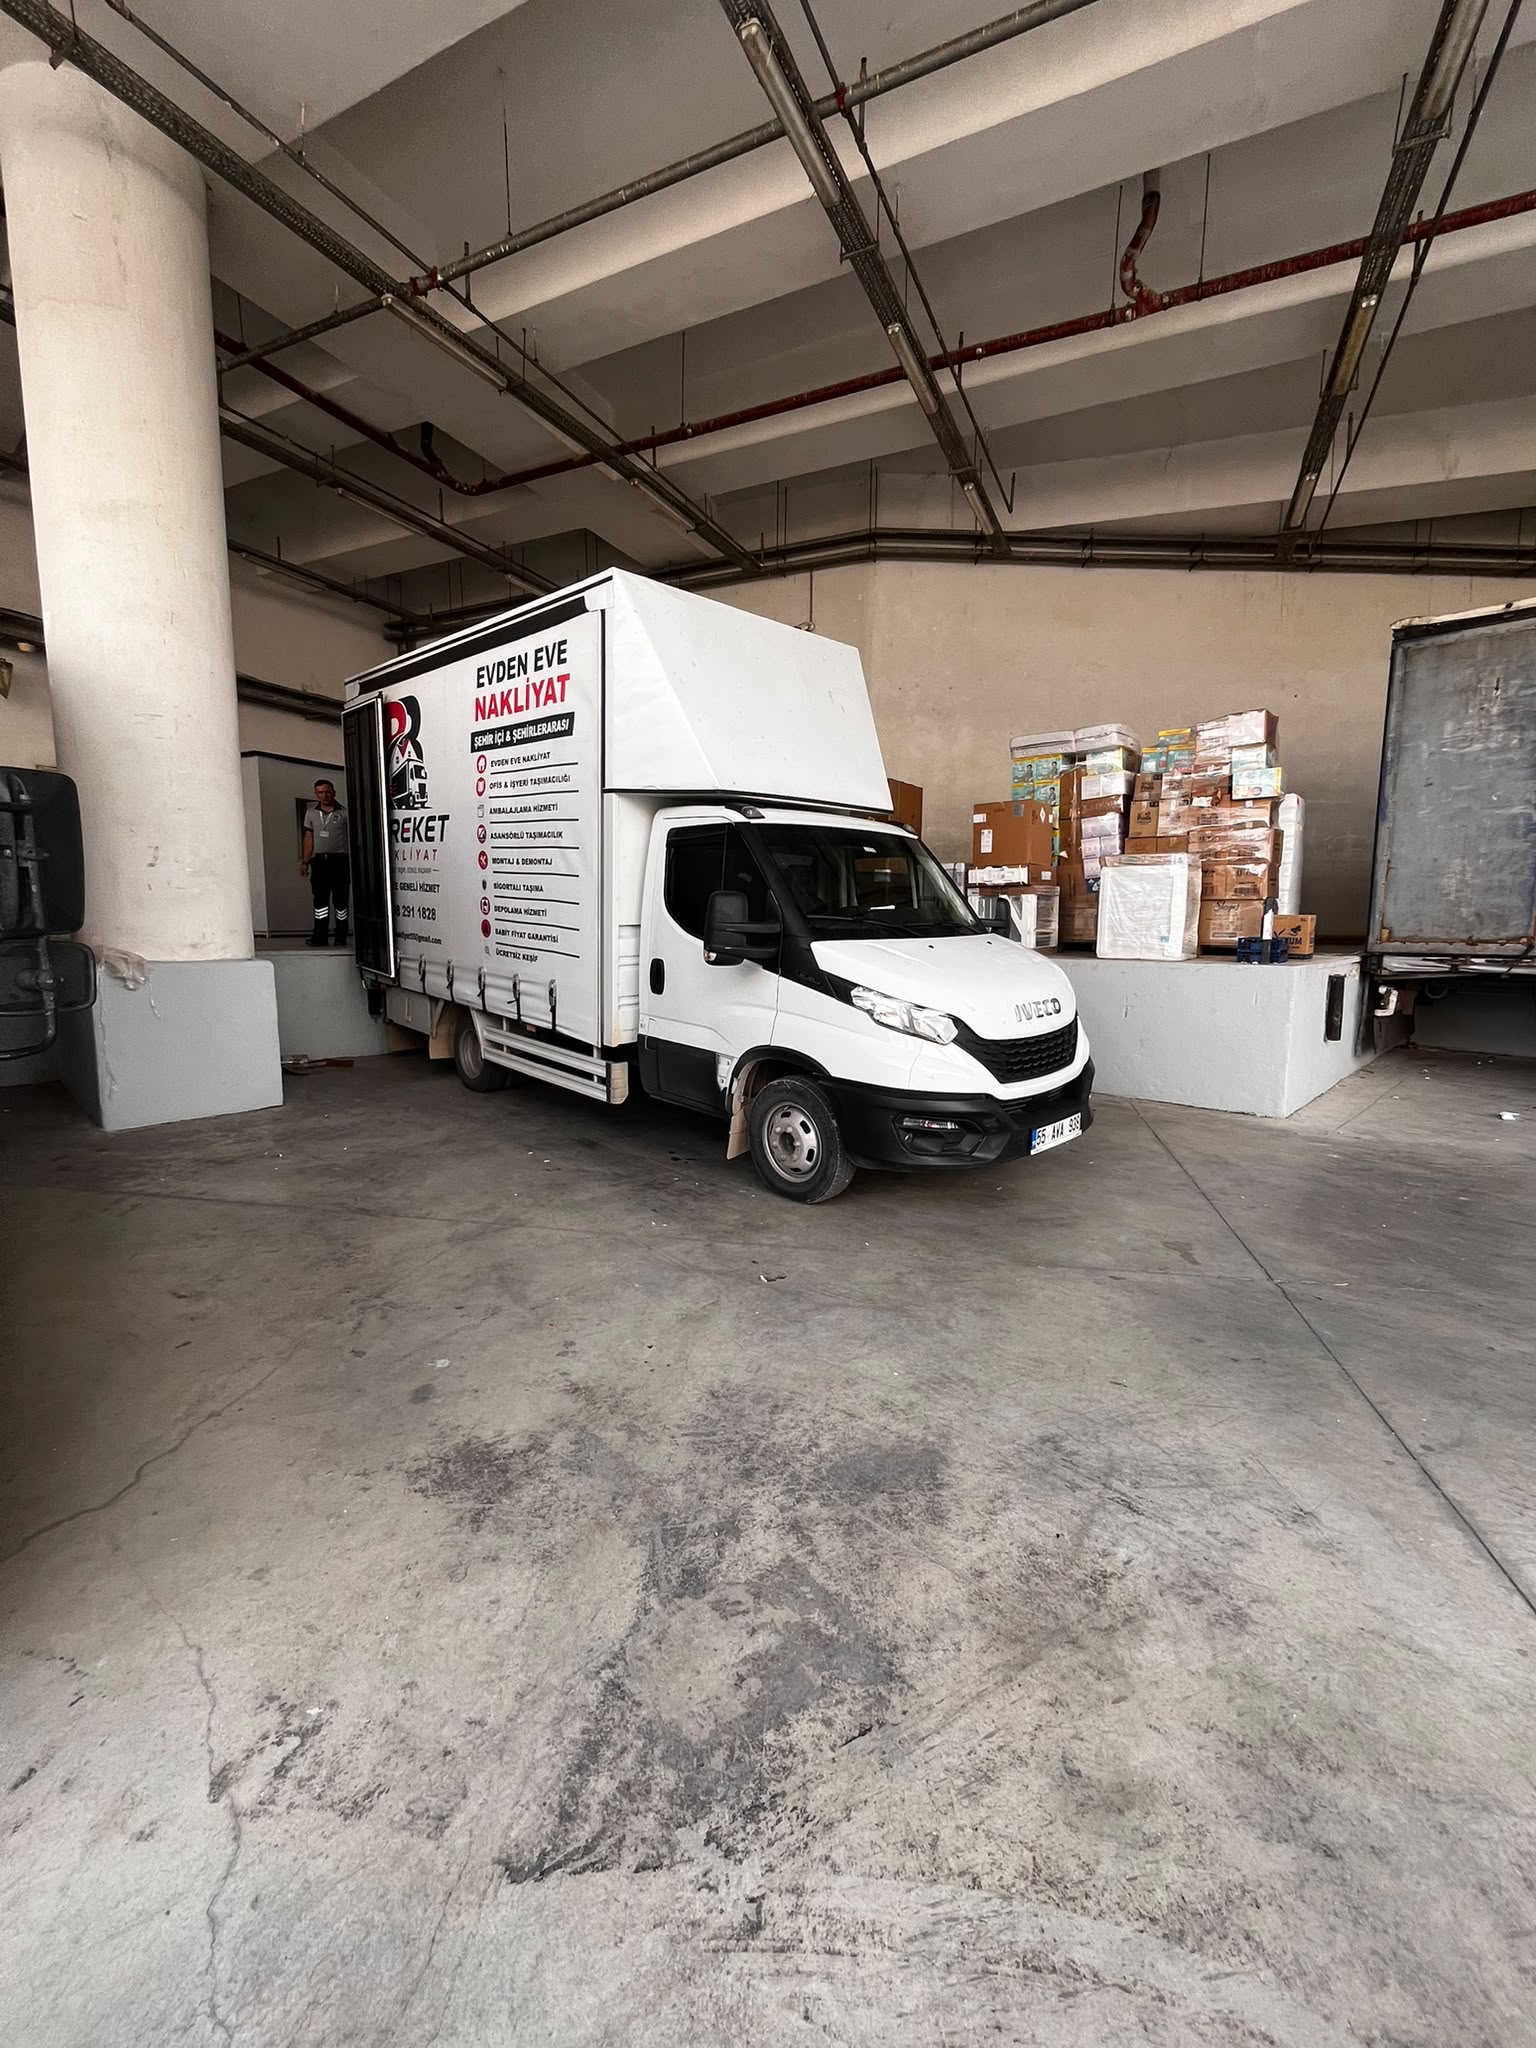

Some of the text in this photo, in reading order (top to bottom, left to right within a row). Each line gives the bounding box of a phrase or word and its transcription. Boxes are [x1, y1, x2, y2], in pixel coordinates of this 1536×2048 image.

[476, 639, 568, 689] EVDEN EVE
[475, 673, 571, 722] NAKLİYAT
[474, 718, 570, 750] ŞEHİR İÇİ & ŞEHİRLERARASI
[490, 752, 551, 768] EVDEN EVE NAKLİYAT
[489, 781, 503, 790] OFİS
[504, 781, 509, 789] &
[510, 778, 529, 789] İŞYERİ
[489, 802, 559, 815] AMBALAJLAMA HİZMETİ
[391, 814, 450, 843] REKET
[394, 847, 438, 861] KLİYAT
[492, 857, 553, 866] MONTAJ & DEMONTAJ
[493, 882, 544, 893] SİGORTALI TAŞIMA
[401, 904, 415, 918] 291
[417, 906, 437, 921] 1828
[494, 905, 548, 917] DEPOLAMA HİZMETİ
[511, 930, 527, 939] FİYAT
[527, 932, 559, 943] GARANTİSİ
[495, 947, 539, 963] ÜCRETSİZ KEŞİF
[1013, 997, 1062, 1023] IVECO
[1036, 1128, 1047, 1146] 55
[1051, 1121, 1064, 1141] AVA
